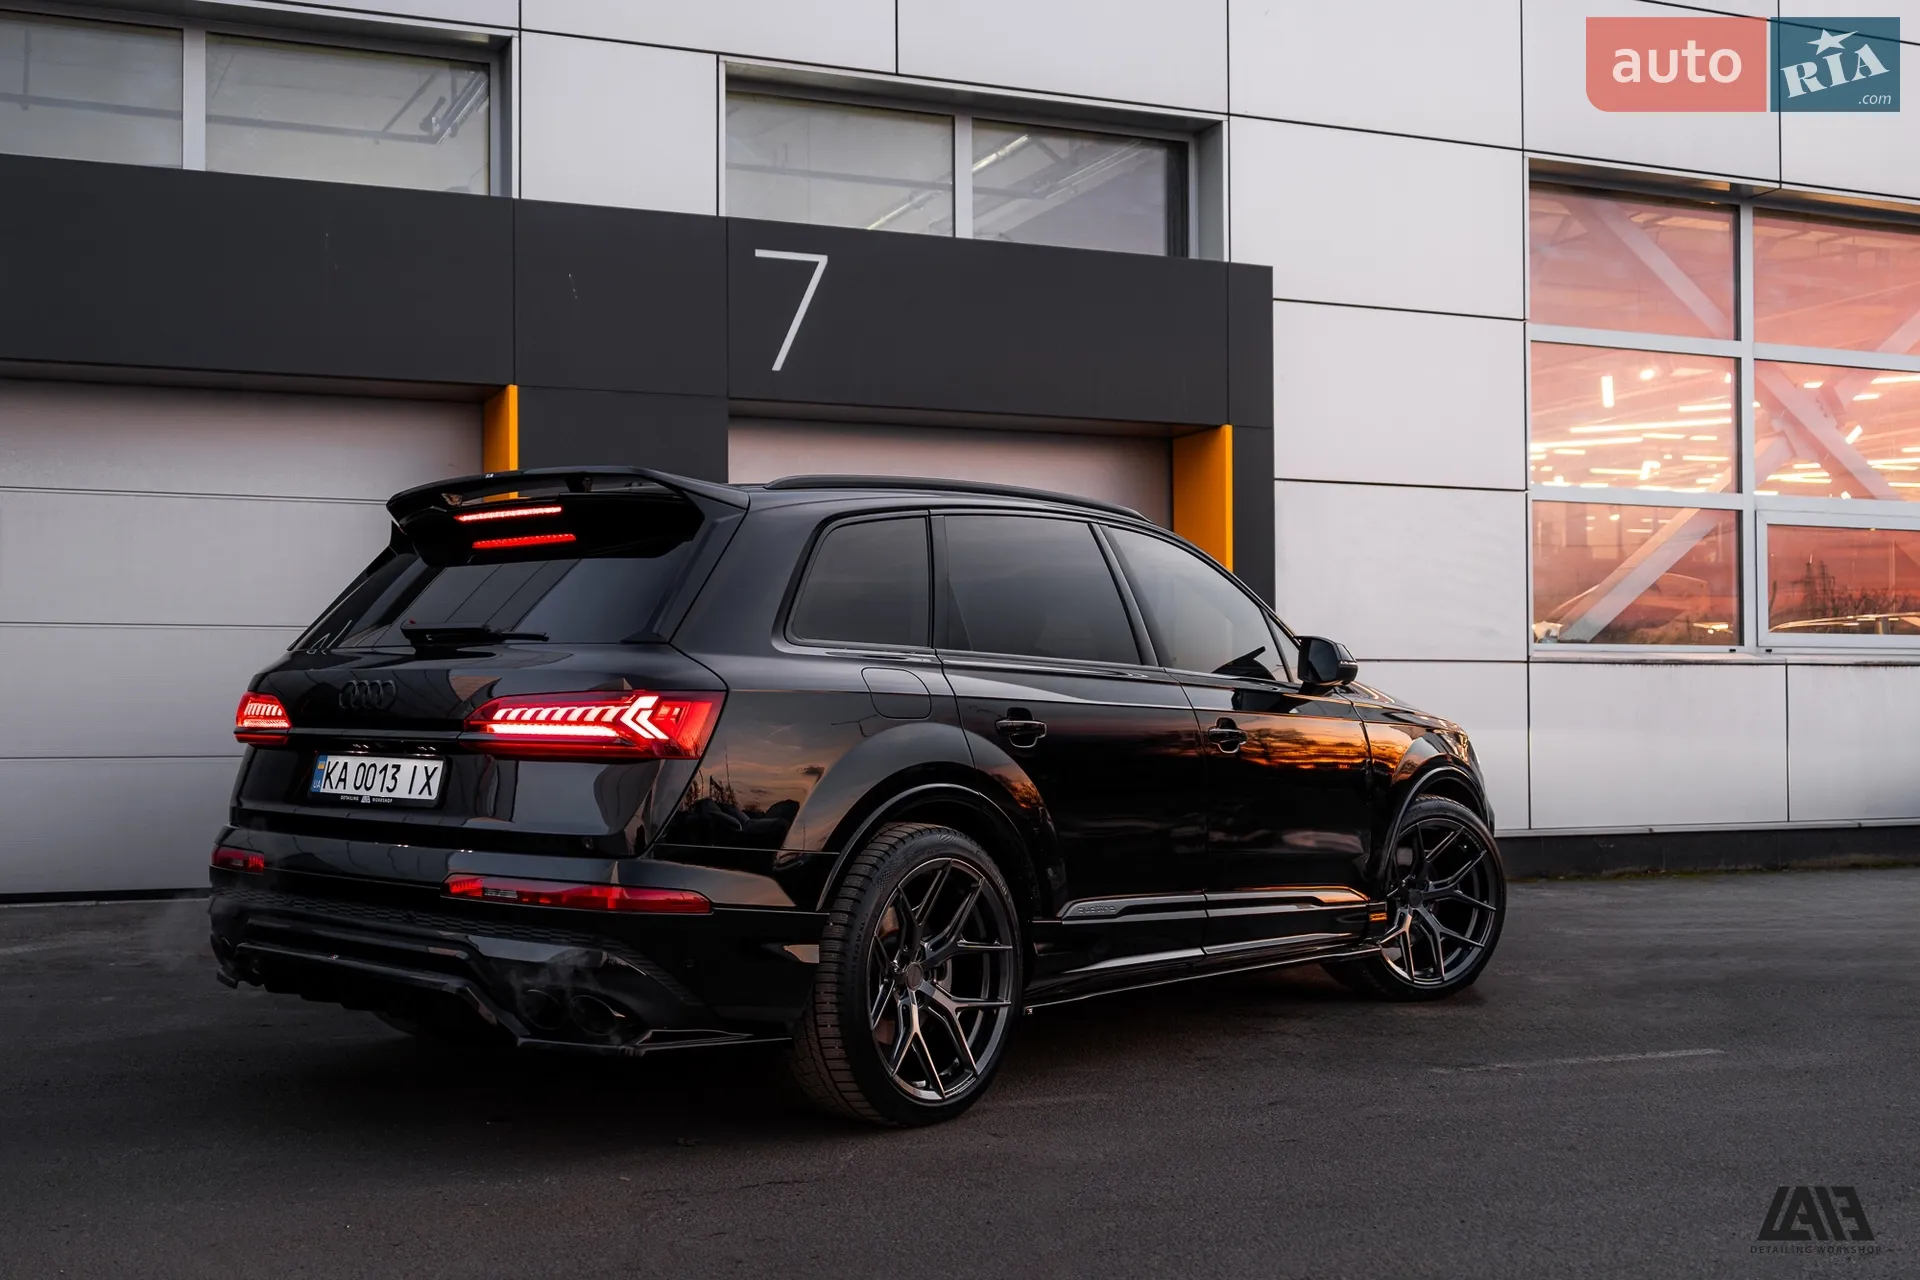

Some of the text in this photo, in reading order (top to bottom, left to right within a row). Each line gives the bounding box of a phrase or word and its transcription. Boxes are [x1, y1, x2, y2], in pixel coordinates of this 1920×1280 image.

[754, 248, 828, 371] 7
[322, 761, 349, 790] KA
[353, 762, 402, 793] 0013
